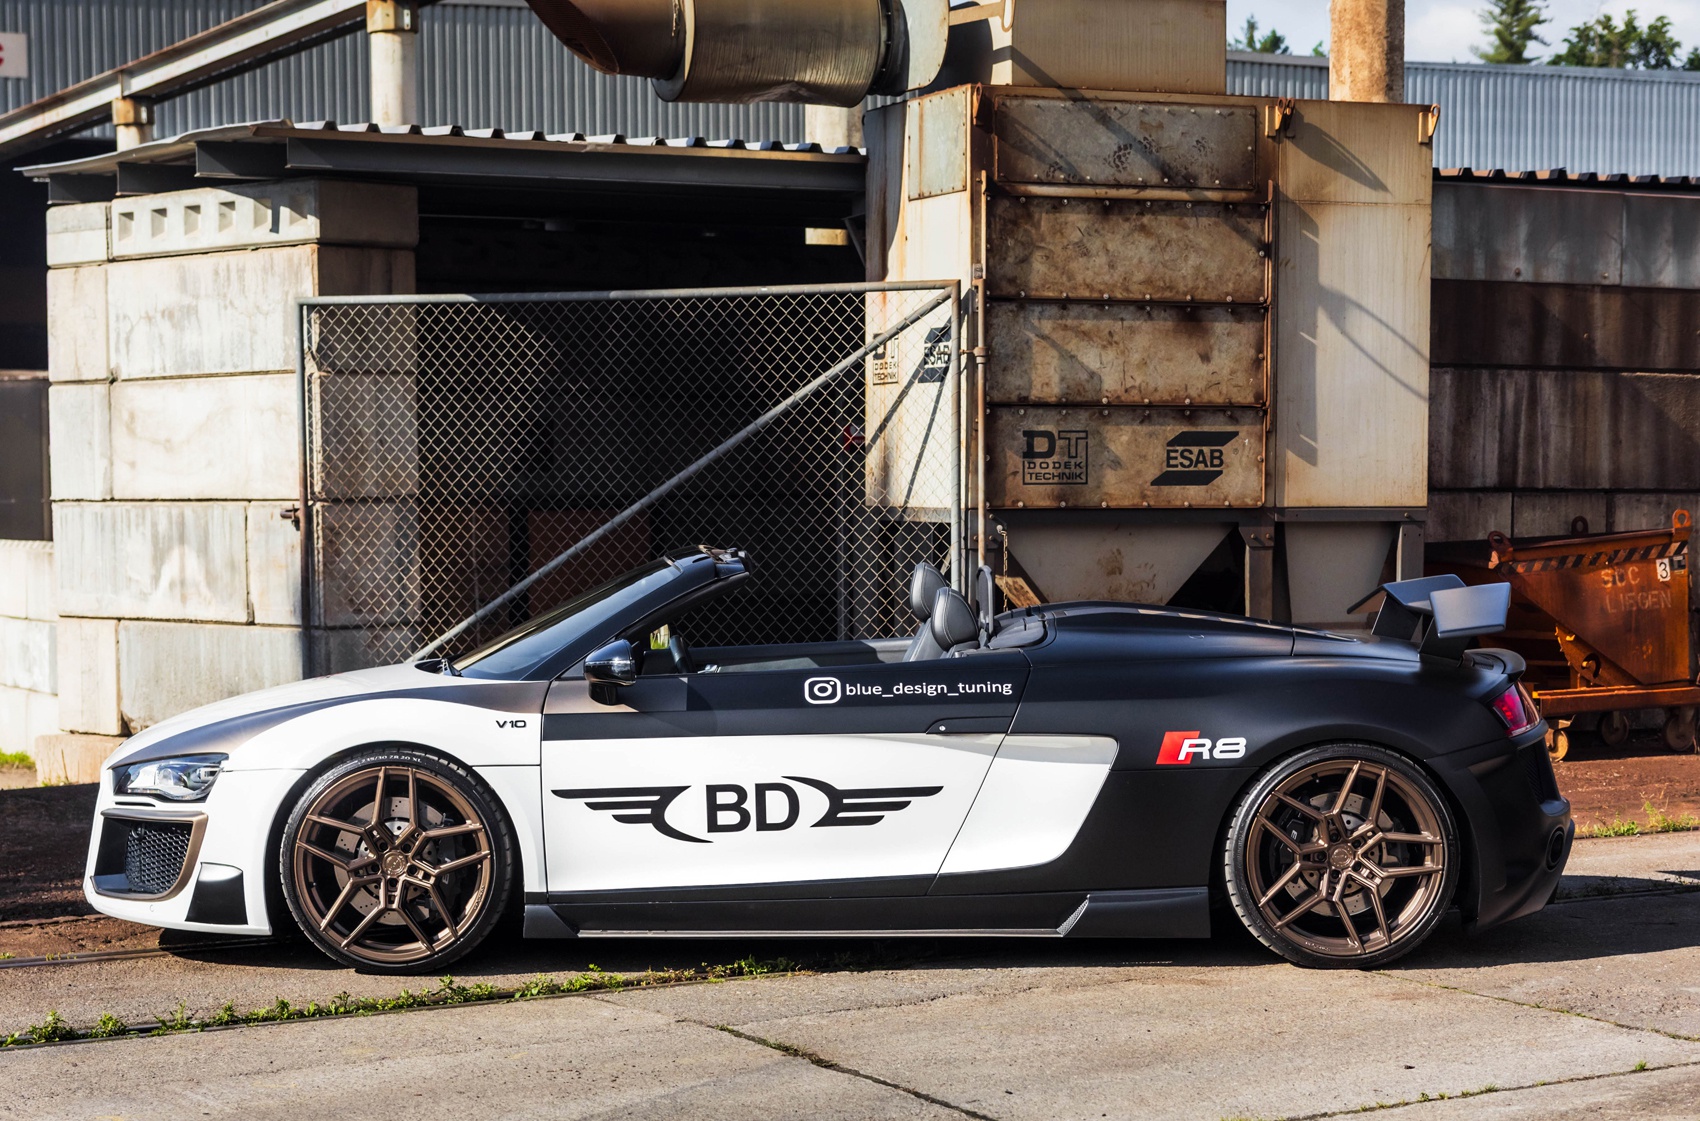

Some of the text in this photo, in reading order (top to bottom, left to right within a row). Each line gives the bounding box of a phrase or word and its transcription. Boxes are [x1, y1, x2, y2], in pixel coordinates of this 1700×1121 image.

[924, 345, 952, 366] ESAB
[874, 361, 897, 370] DODEK
[874, 372, 897, 381] TECHNIK
[1022, 430, 1088, 459] DT
[1026, 461, 1084, 470] DODEK
[1165, 448, 1224, 469] ESAB
[1027, 472, 1084, 481] TECHNIK
[1658, 561, 1669, 579] 3
[845, 682, 1013, 697] blue_design_tuning
[495, 719, 527, 729] V10
[1177, 737, 1247, 761] R8
[706, 782, 800, 833] BD
